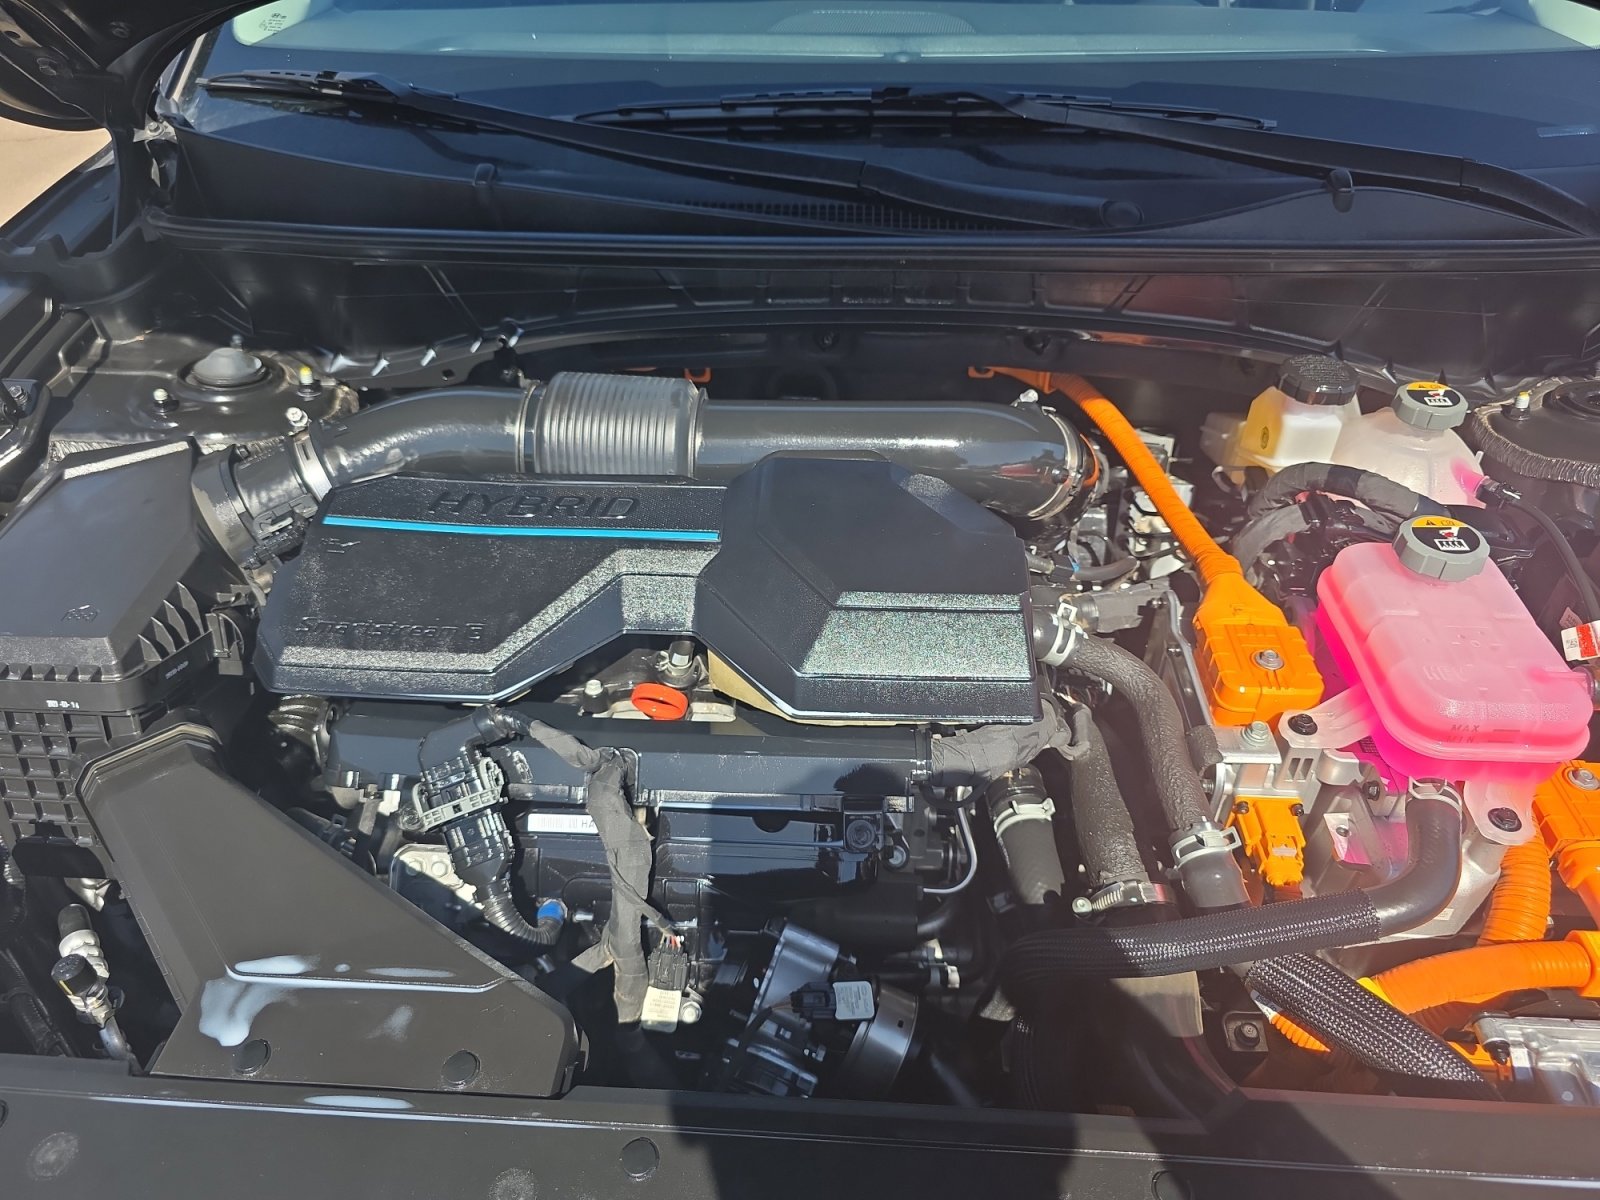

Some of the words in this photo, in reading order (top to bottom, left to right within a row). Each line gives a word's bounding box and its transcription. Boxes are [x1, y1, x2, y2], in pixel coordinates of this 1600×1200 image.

[428, 491, 639, 520] HYBRID
[1450, 724, 1480, 733] MAX
[1446, 736, 1475, 744] MIN
